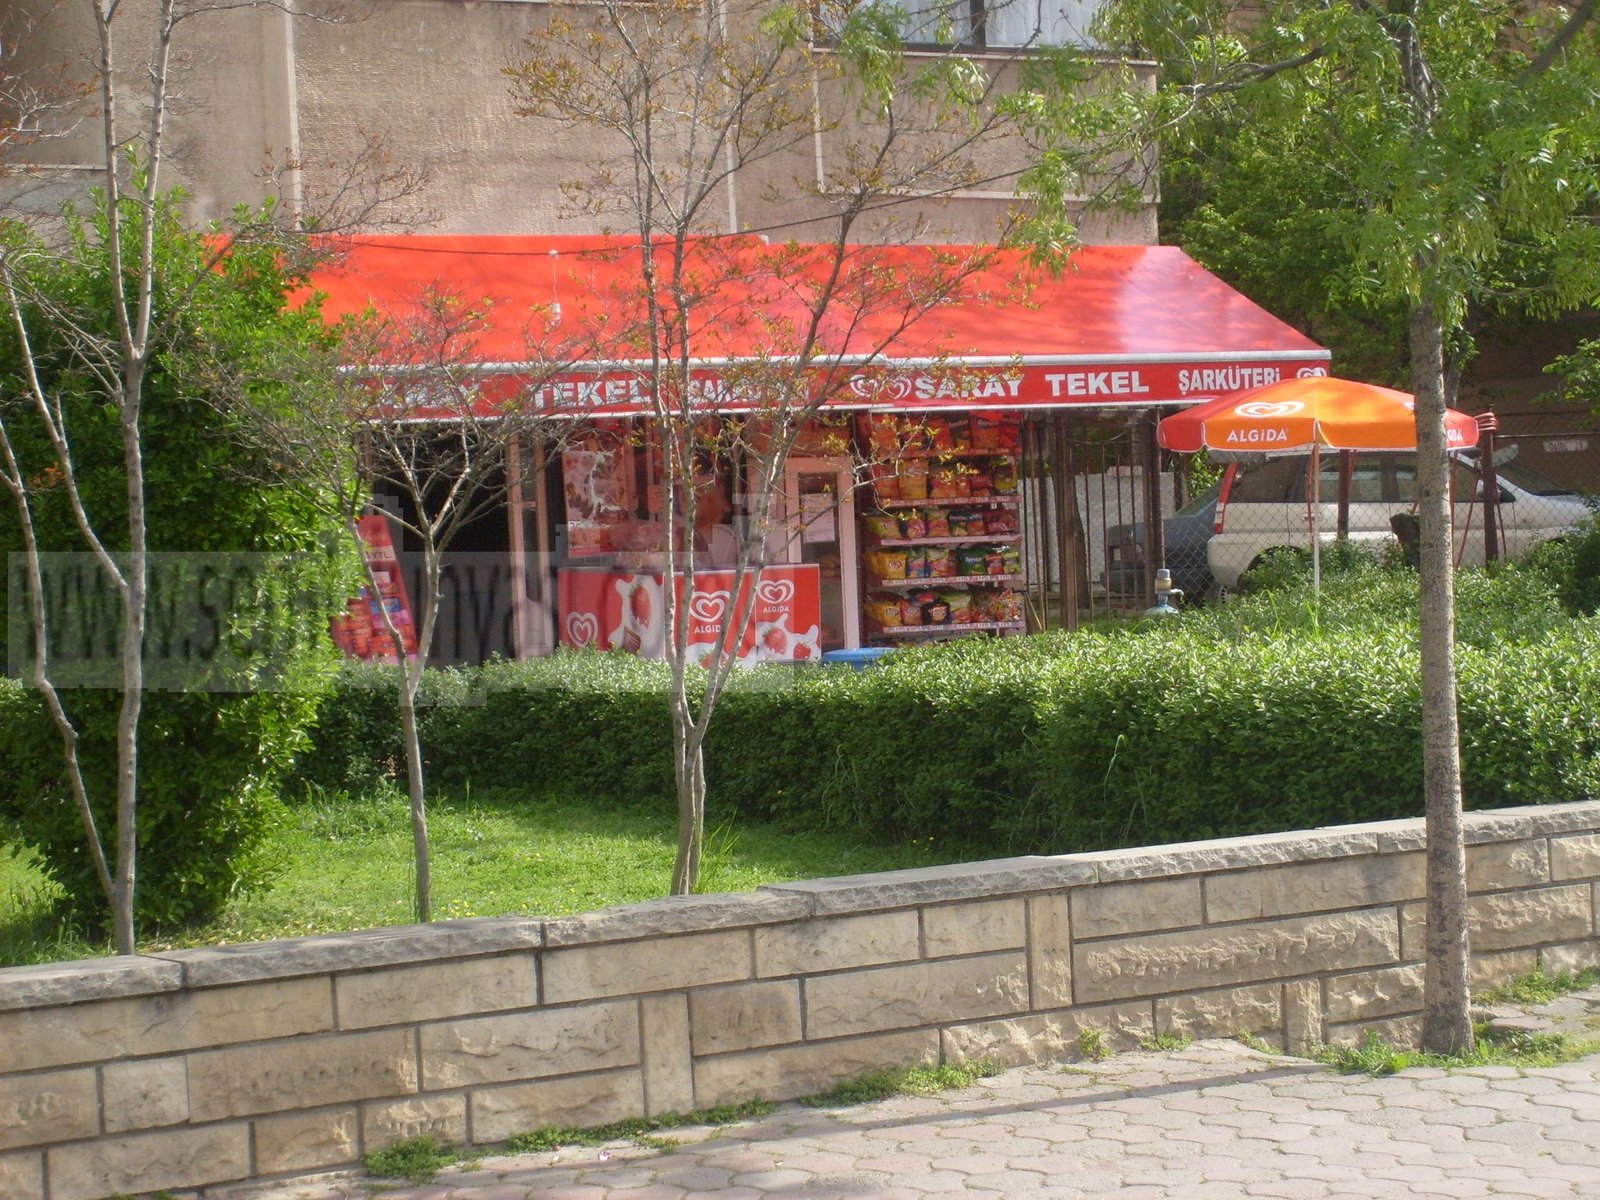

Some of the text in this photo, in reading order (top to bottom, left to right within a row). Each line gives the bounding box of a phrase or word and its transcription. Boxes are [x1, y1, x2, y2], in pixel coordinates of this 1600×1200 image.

[528, 379, 652, 408] TEKEL
[915, 373, 1025, 399] SARAY
[1045, 370, 1149, 396] TEKEL
[1226, 428, 1288, 443] ALGiDA
[693, 624, 722, 634] ALGiD
